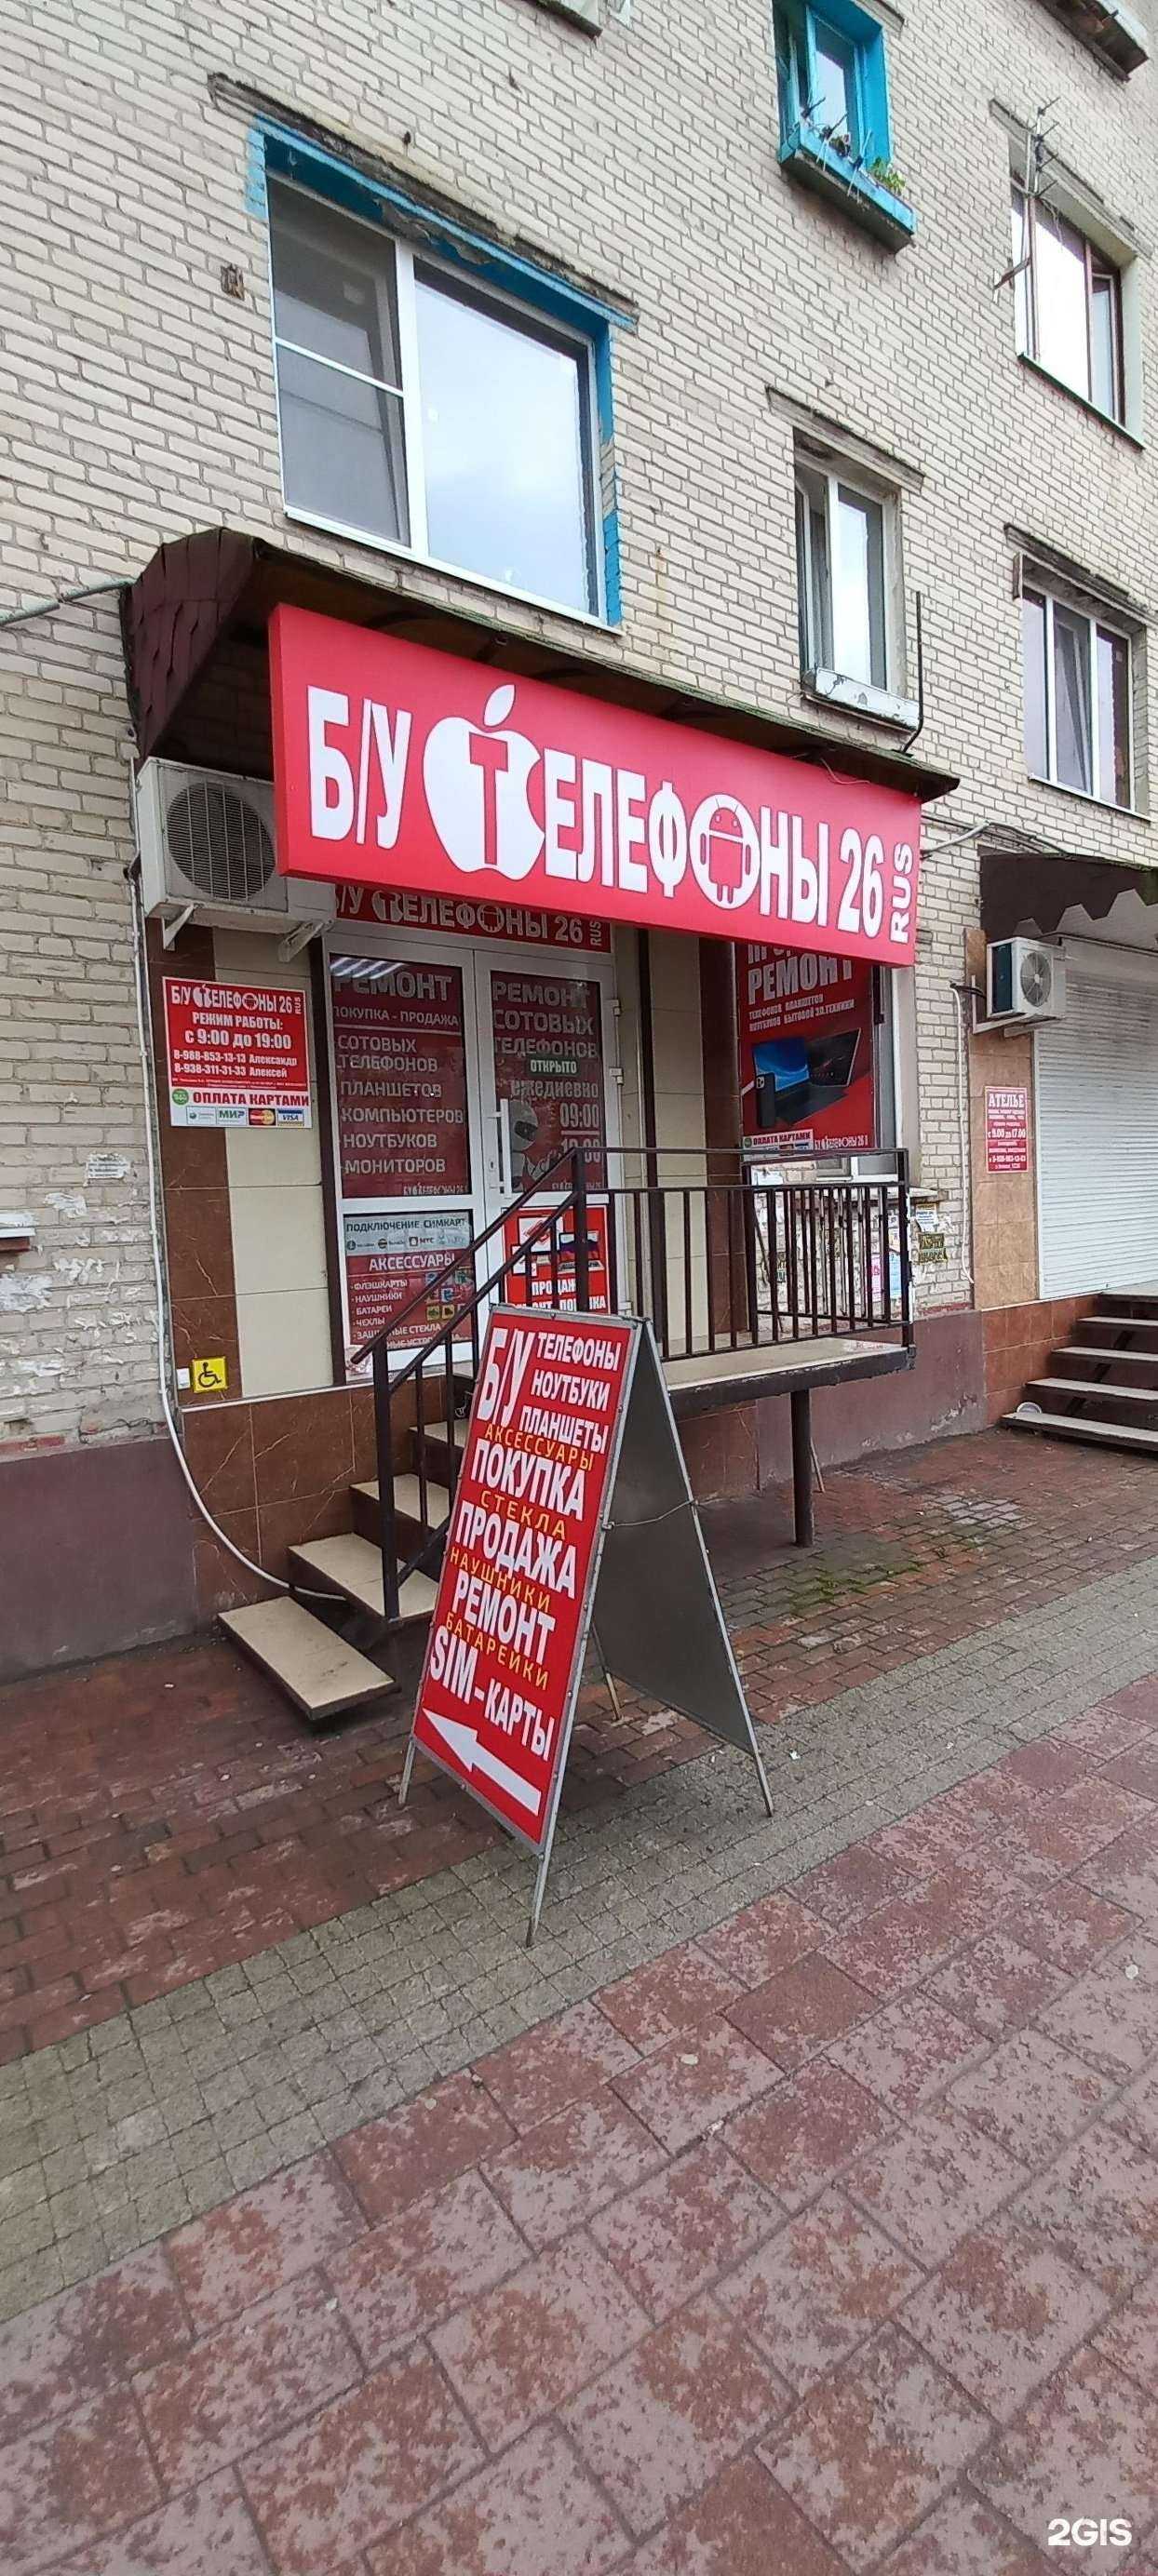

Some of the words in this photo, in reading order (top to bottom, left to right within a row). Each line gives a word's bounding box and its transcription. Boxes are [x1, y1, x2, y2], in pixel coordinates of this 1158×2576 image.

[307, 685, 412, 850] Б/У
[424, 715, 828, 924] ТЕЛЕФОНЫ
[839, 827, 883, 938] 26
[890, 841, 913, 944] RUS
[335, 884, 364, 914] /У
[372, 890, 547, 939] ТЕЛЕФОНЫ
[555, 916, 583, 944] 26
[589, 921, 602, 946] RUS
[171, 986, 192, 1005] Б/У
[193, 986, 277, 1013] ТЕЛЕФОНЫ
[279, 996, 292, 1014] 26
[192, 1012, 234, 1026] РЕЖИМ
[236, 1015, 283, 1030] РАБОТЫ:
[400, 1011, 459, 1026] ПРОДАЖА
[493, 1009, 594, 1036] СОТОВЫХ
[196, 1028, 230, 1046] 9:00
[233, 1034, 252, 1048] до
[254, 1033, 292, 1050] 19:00
[338, 1035, 418, 1053] СОТОВЫХ
[337, 1054, 438, 1072] ТЕЛЕФОНОВ
[530, 1059, 577, 1074] ОТКРЫТО
[249, 1067, 288, 1079] Алексей
[341, 1081, 442, 1097] ПЛАНШЕТОВ
[511, 1080, 599, 1099] ежедневно
[193, 1092, 247, 1106] ОПЛАТА
[249, 1093, 310, 1107] КАРТАМИ
[989, 1093, 1025, 1108] АТЕЛЬЕ
[219, 1109, 246, 1119] МИР
[342, 1107, 464, 1124] КОМПЬЮТЕРОВ
[560, 1102, 599, 1128] 09:00
[343, 1133, 438, 1149] НОУТБУКОВ
[344, 1158, 446, 1174] МОНИТОРОВ
[346, 1220, 420, 1233] ПОДКЛЮЧЕНИЕ
[370, 1252, 455, 1271] АКСЕССУАРЫ
[356, 1291, 403, 1304] НАУШНИКИ
[410, 1322, 441, 1333] СТЕКЛА
[477, 1326, 536, 1428] Б/У
[536, 1331, 622, 1372] ТЕЛЕФОНЫ
[530, 1369, 611, 1412] НОУТБУКИ
[518, 1404, 610, 1455] ПЛАНШЕТЫ
[484, 1424, 595, 1471] АКСЕССУАРЫ
[470, 1438, 586, 1522] ПОКУПКА
[479, 1490, 567, 1540] СТЕКЛА
[454, 1499, 577, 1600] ПРОДАЖА
[450, 1546, 552, 1612] НАУШНИКИ
[452, 1568, 557, 1666] РЕМОНТ
